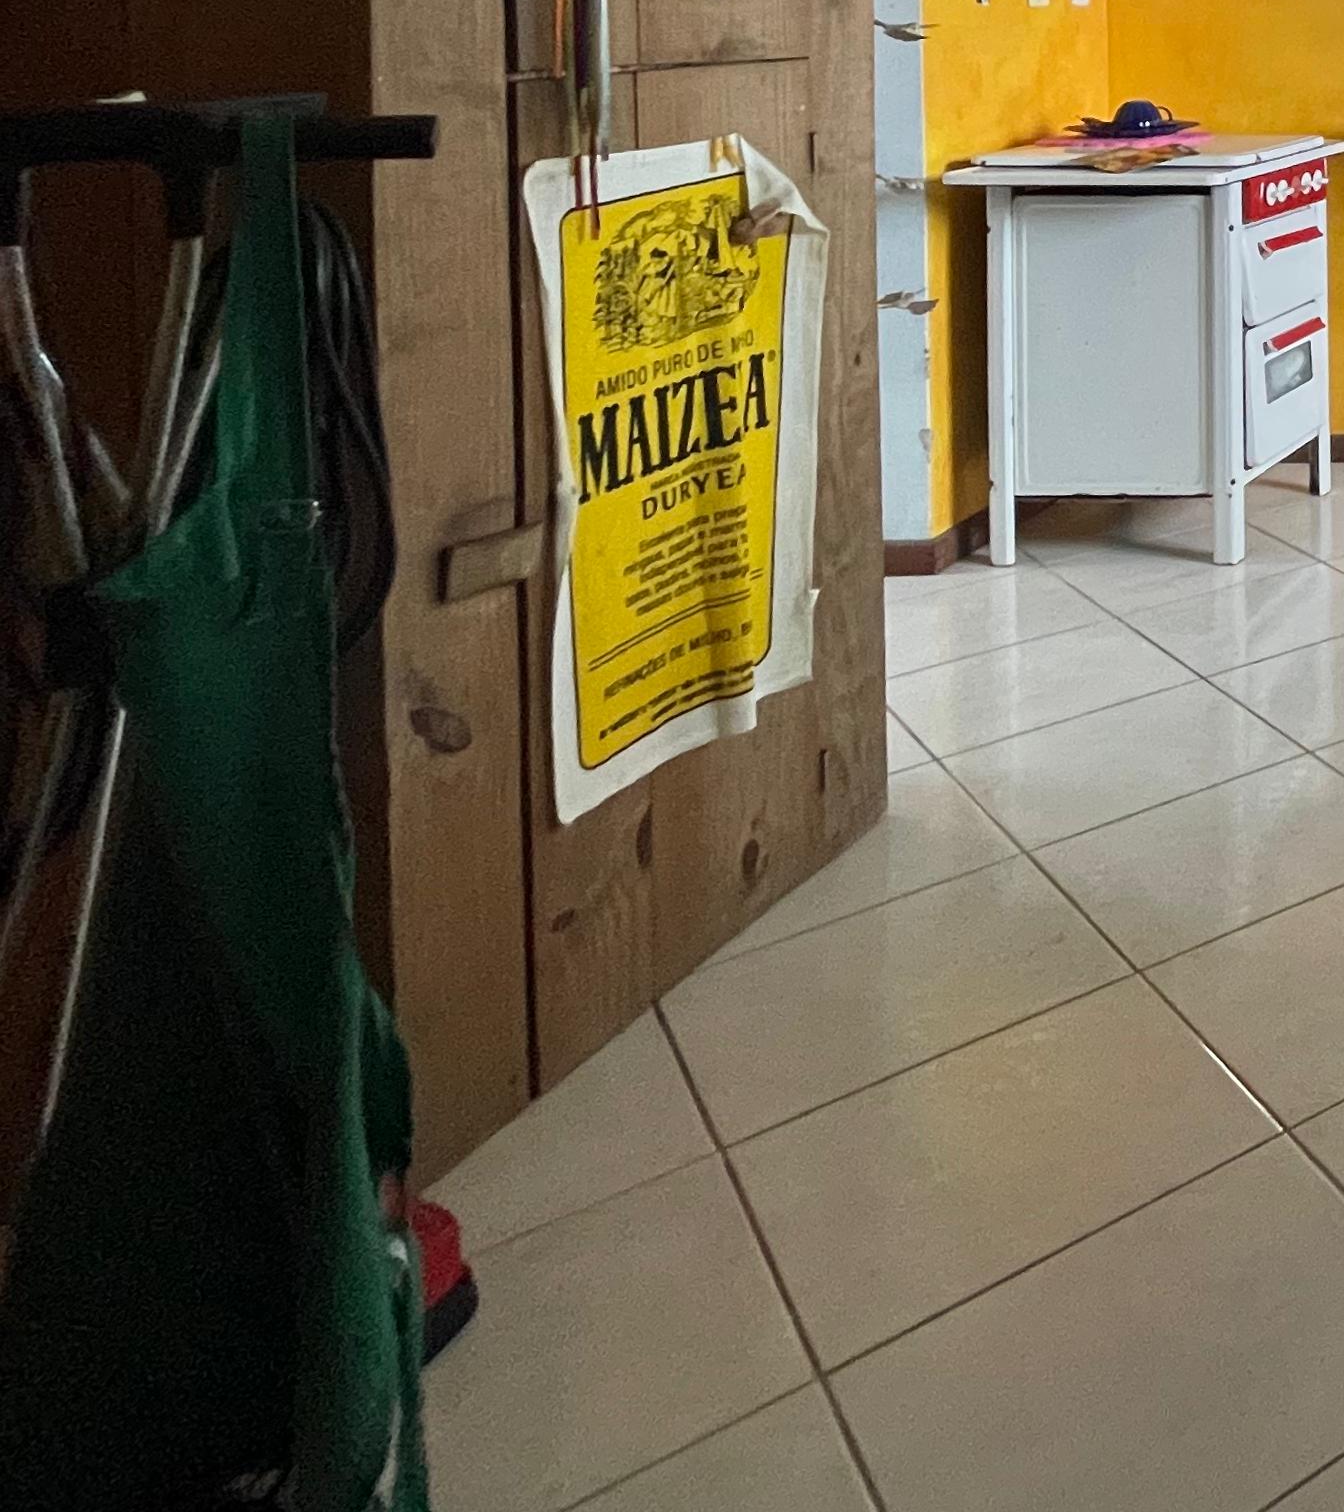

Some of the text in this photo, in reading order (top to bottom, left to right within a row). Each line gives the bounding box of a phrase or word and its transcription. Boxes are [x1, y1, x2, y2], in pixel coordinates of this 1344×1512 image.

[596, 366, 647, 399] AMIDO
[653, 350, 694, 379] PURO
[697, 340, 723, 363] DE
[578, 353, 770, 505] MAIZEA
